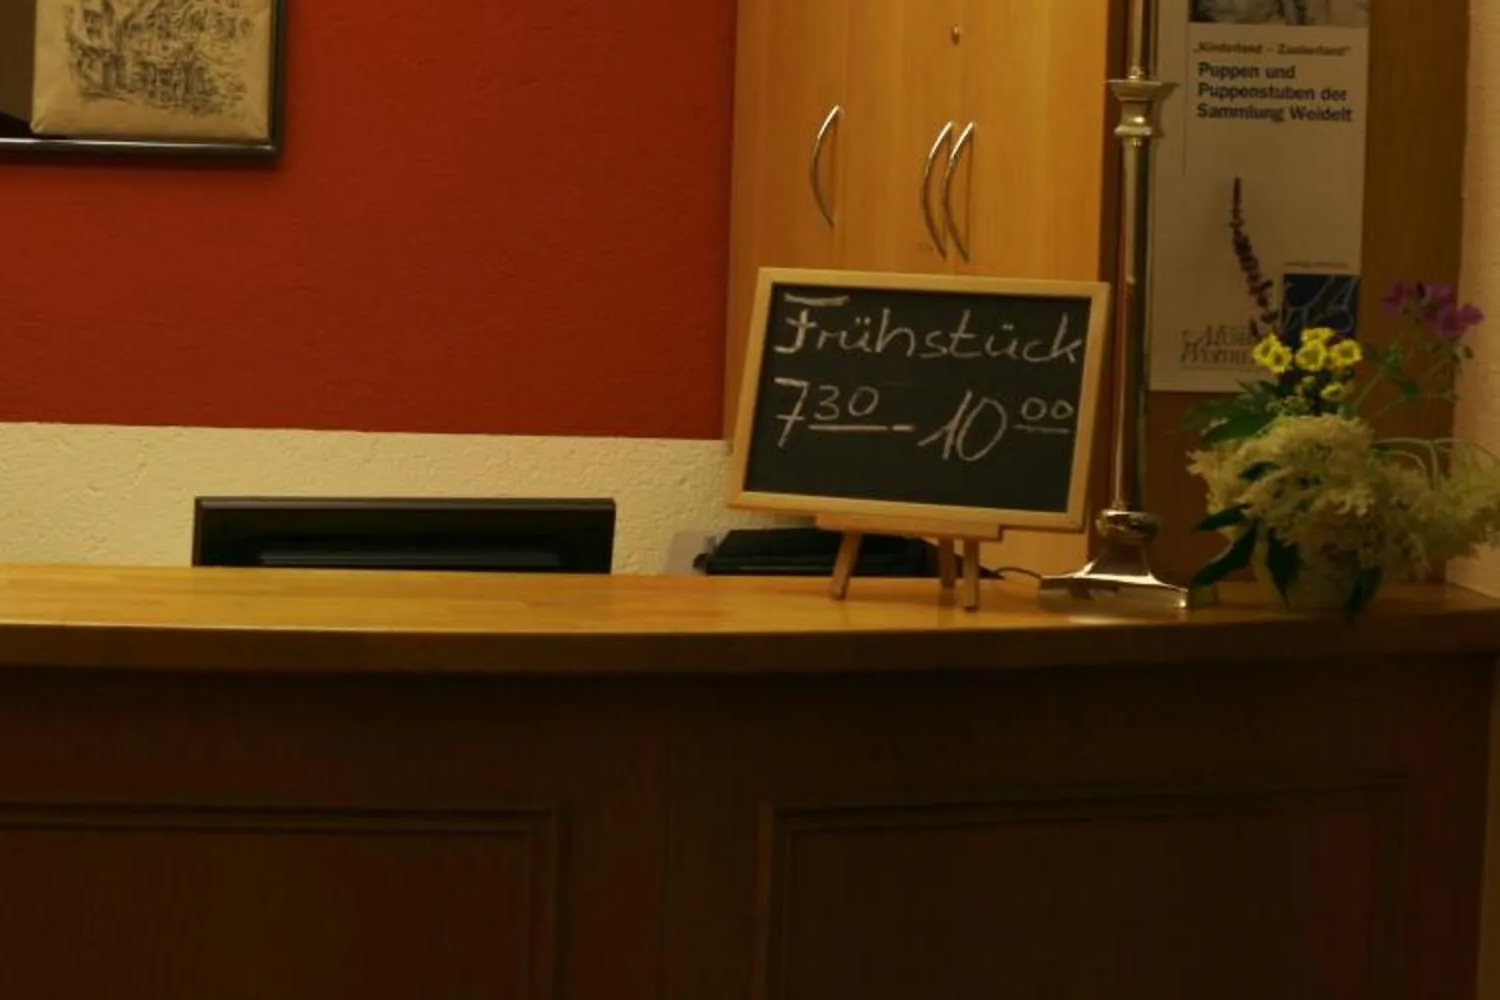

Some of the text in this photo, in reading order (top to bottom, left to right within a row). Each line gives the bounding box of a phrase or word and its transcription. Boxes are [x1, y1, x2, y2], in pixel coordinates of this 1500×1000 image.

[1197, 61, 1296, 81] Puppen und
[1197, 82, 1348, 102] Puppenstuben der
[1196, 102, 1285, 122] Sammlung
[773, 291, 1085, 364] Frühstück
